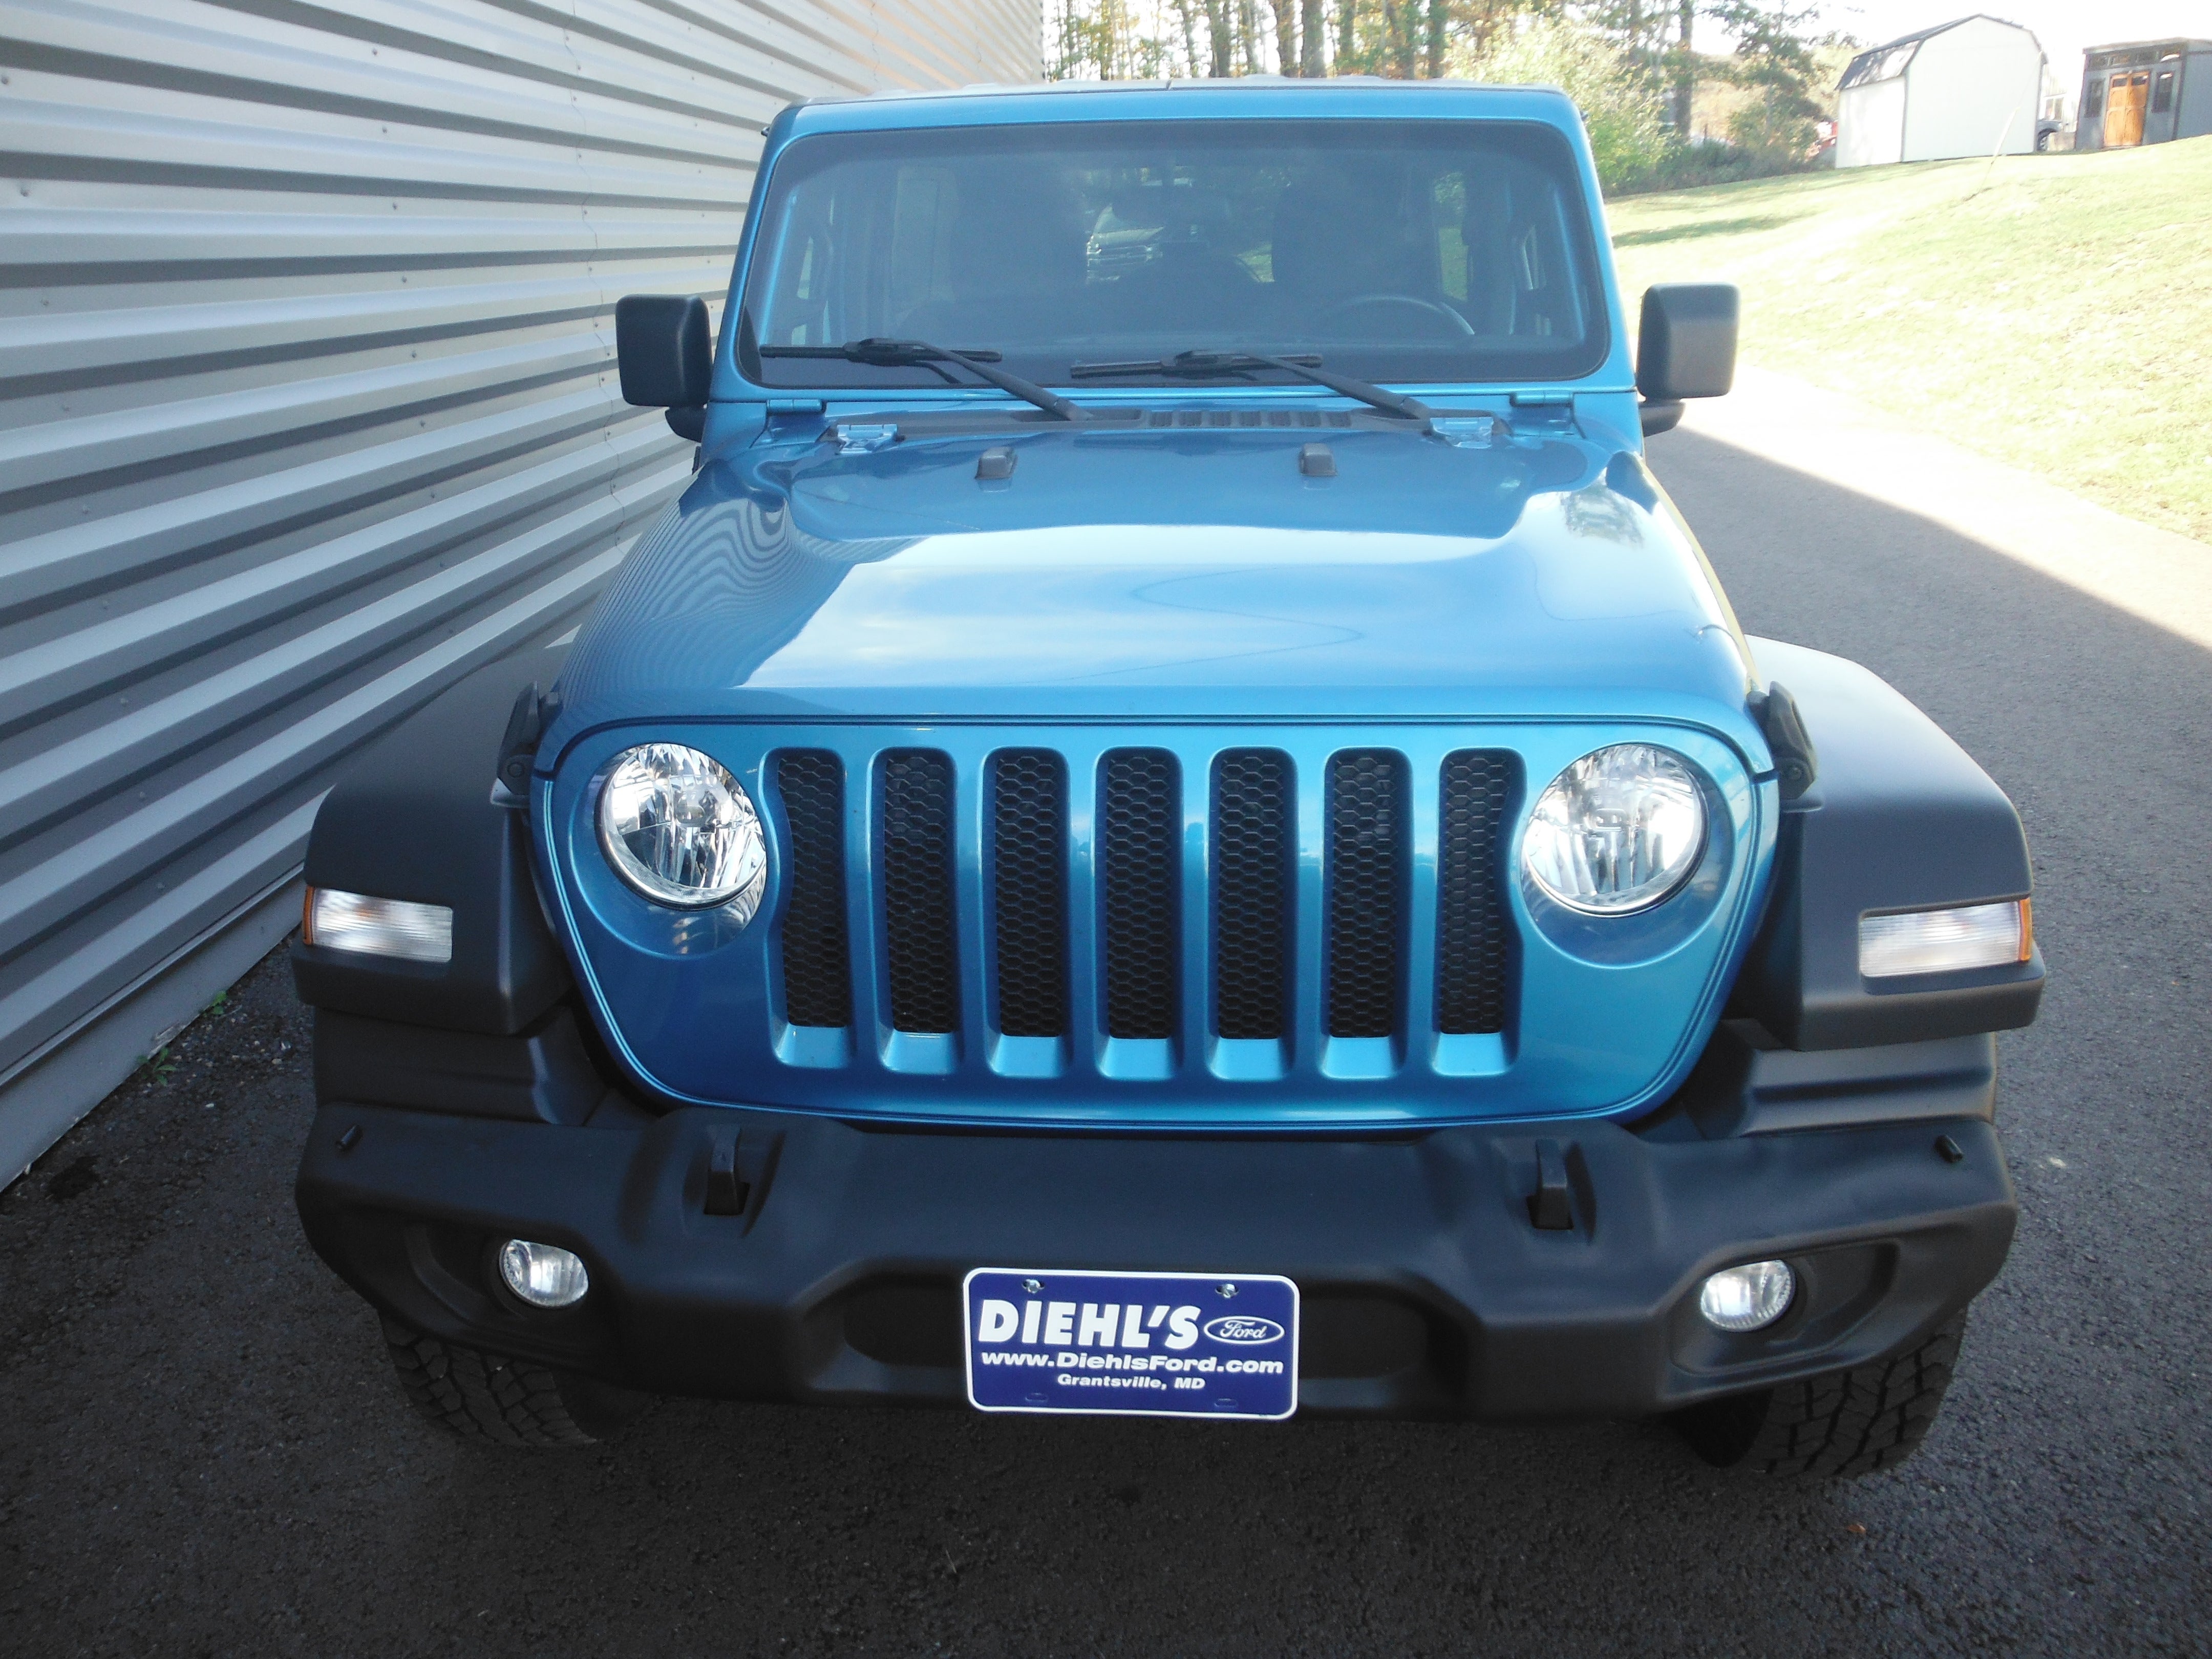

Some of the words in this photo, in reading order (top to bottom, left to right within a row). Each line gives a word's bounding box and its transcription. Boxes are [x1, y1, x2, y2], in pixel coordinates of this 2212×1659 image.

[978, 1299, 1201, 1349] DIEHL'S
[1220, 1321, 1266, 1339] Ford
[981, 1352, 1284, 1373] www.DiehlsFord.com
[1057, 1373, 1167, 1390] Grantsville,
[1174, 1377, 1206, 1389] MD
